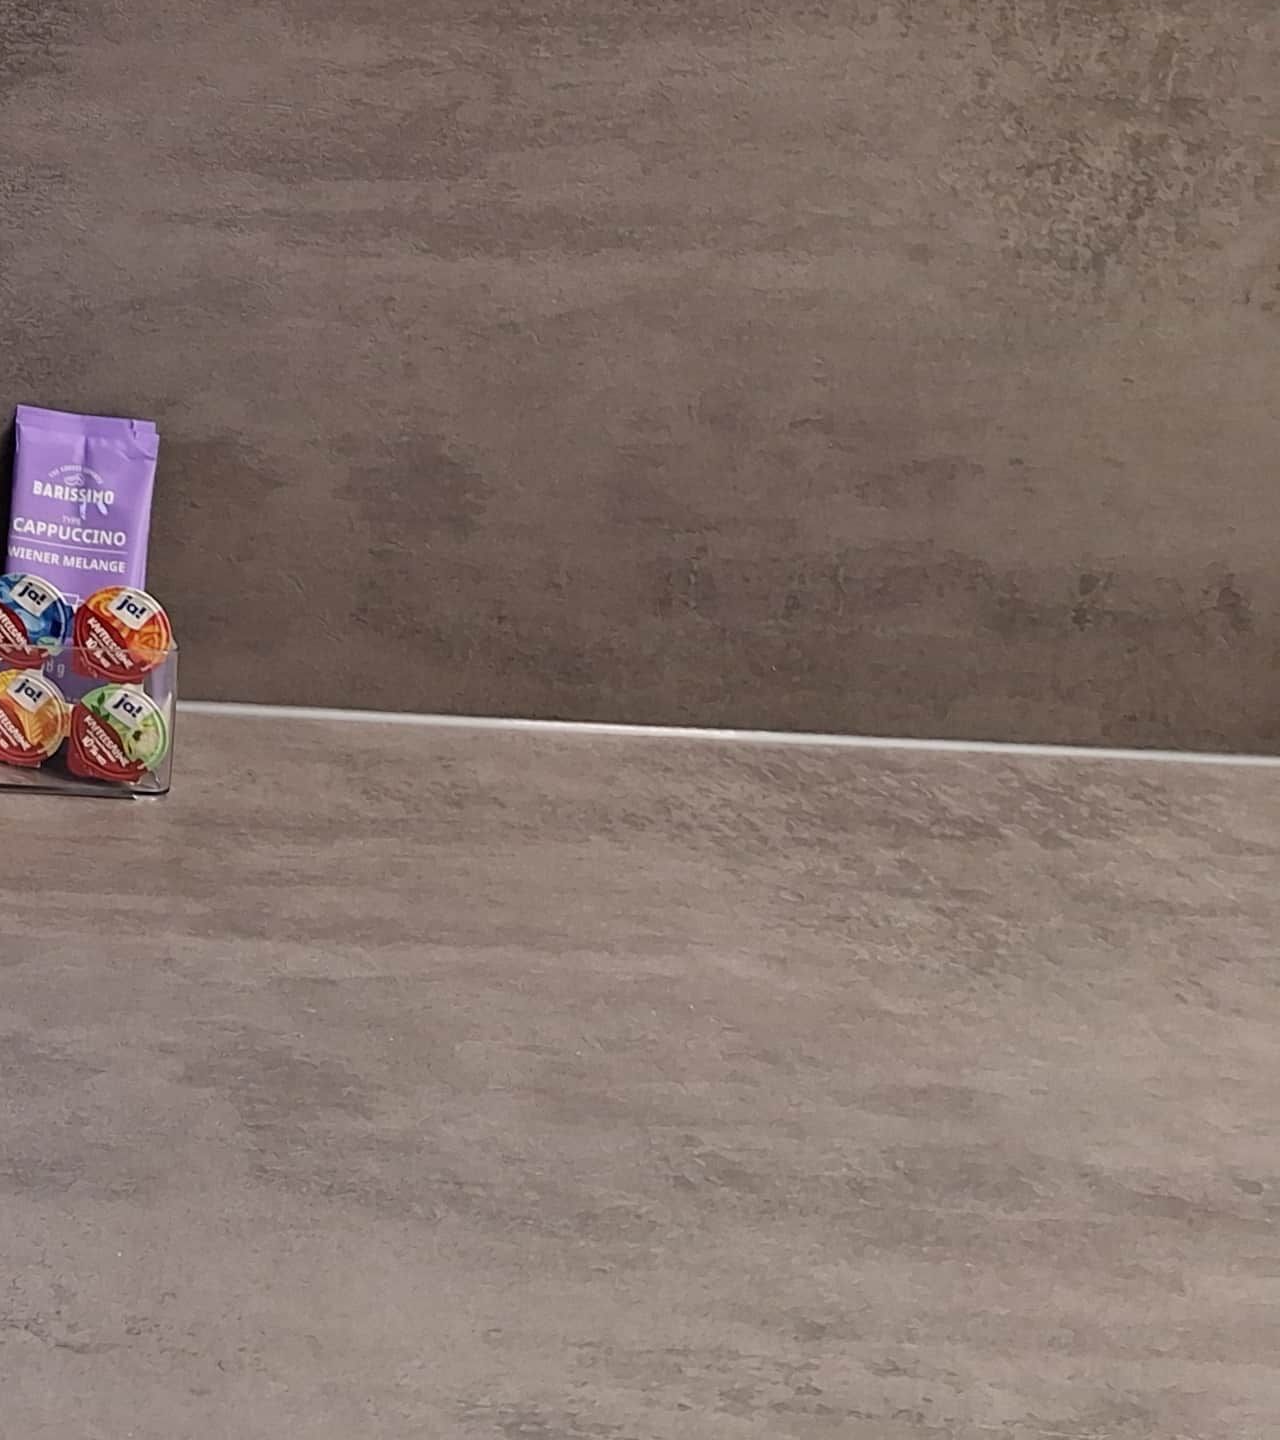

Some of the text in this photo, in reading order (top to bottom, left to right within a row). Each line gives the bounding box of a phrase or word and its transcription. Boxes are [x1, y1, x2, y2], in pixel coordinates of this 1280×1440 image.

[32, 480, 115, 505] BARISSIMO
[13, 517, 126, 546] CAPPUCCINO
[7, 545, 126, 573] WIENER MELANGE
[17, 582, 46, 606] ja!
[116, 595, 147, 620] ja!
[14, 678, 43, 703] ja!
[112, 694, 144, 718] ja!
